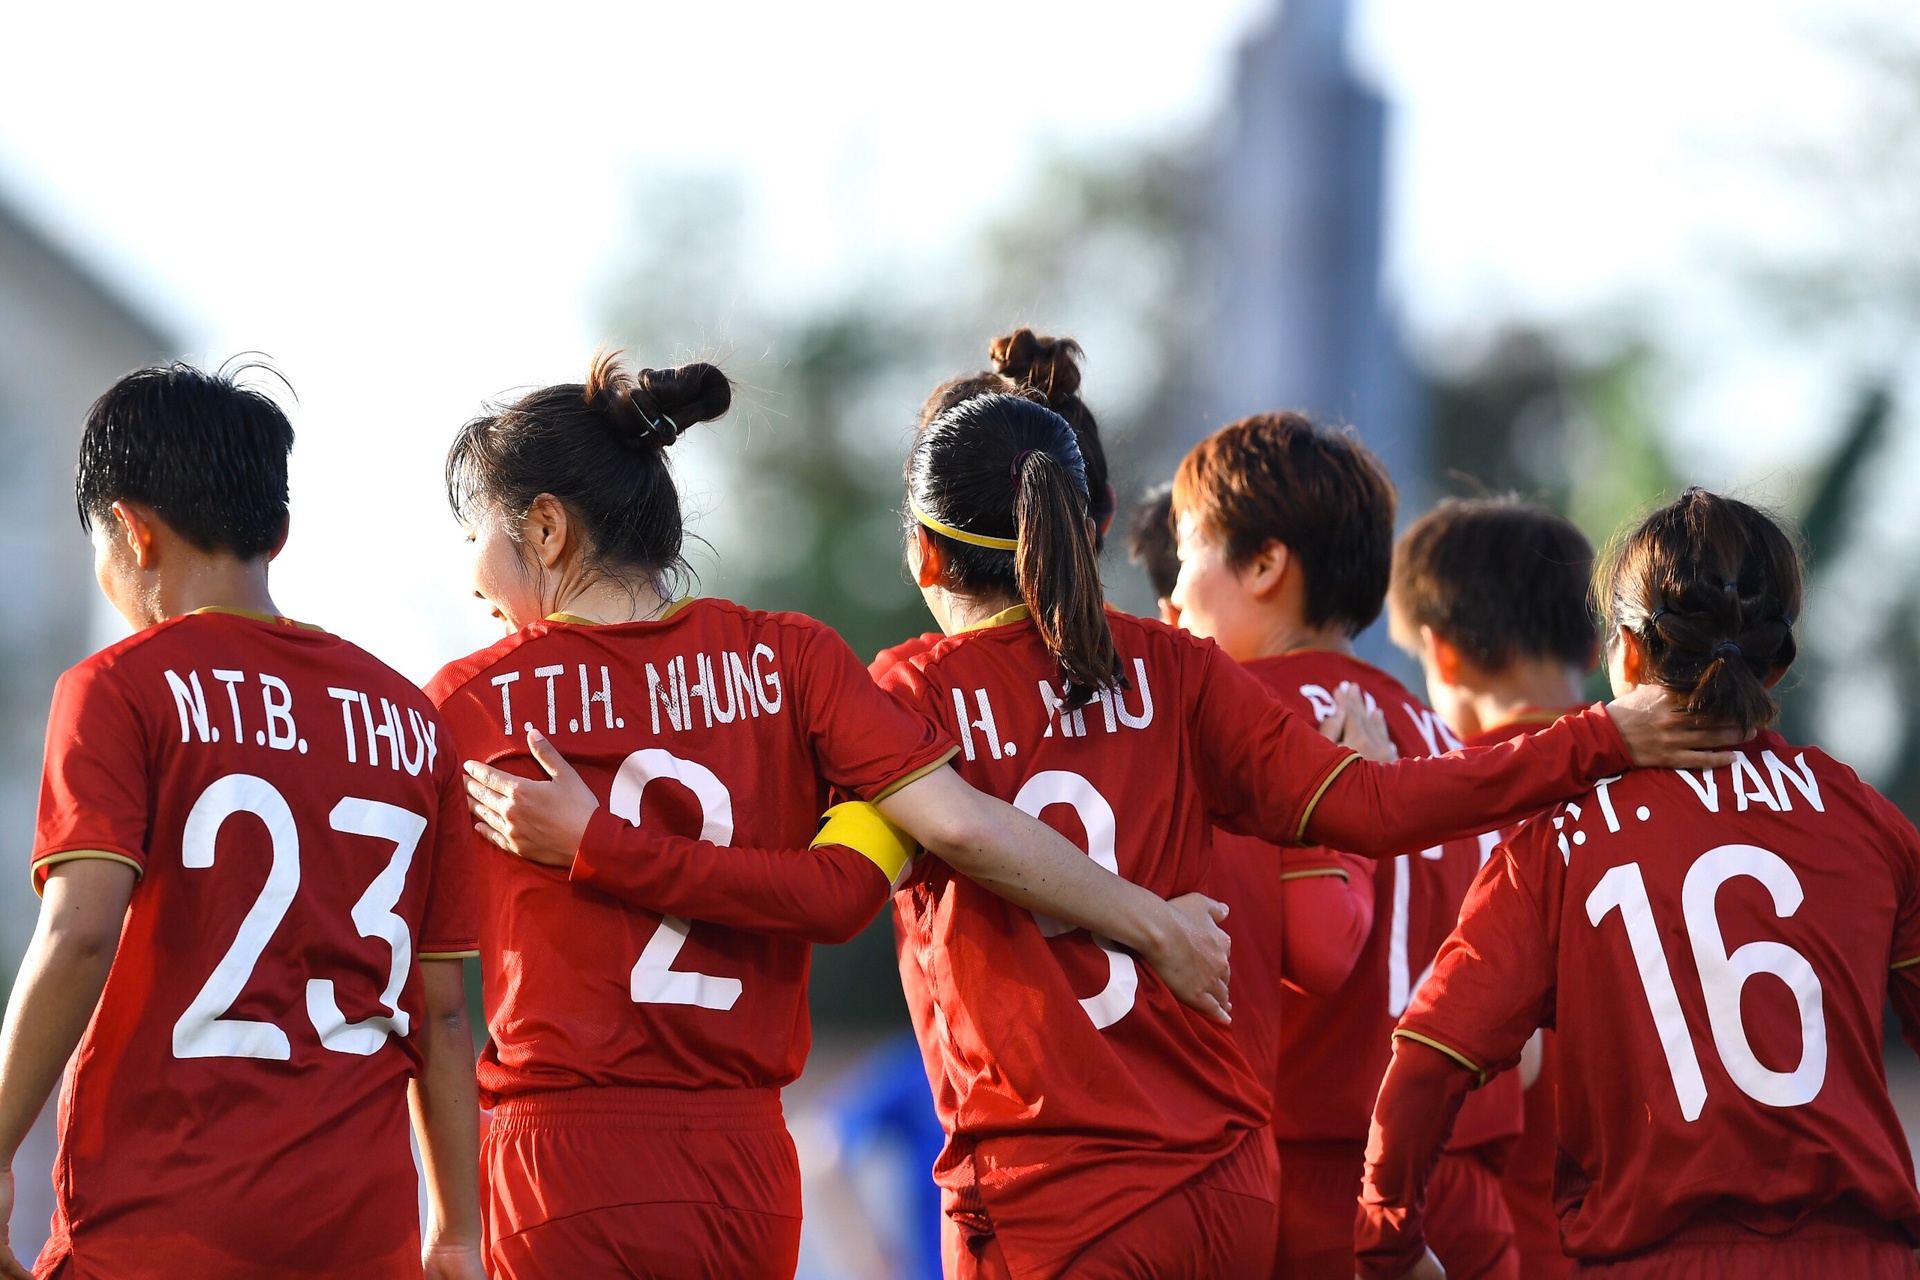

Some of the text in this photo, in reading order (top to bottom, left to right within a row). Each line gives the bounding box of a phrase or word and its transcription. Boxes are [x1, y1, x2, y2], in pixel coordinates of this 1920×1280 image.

[164, 669, 437, 776] N.T.B. THUY
[491, 643, 782, 735] T.T.H. NHUNG
[951, 687, 1017, 761] H.
[1675, 749, 1825, 813] VAN
[172, 774, 427, 1060] 23
[609, 748, 743, 1011] 2
[1585, 844, 1828, 1122] 16
